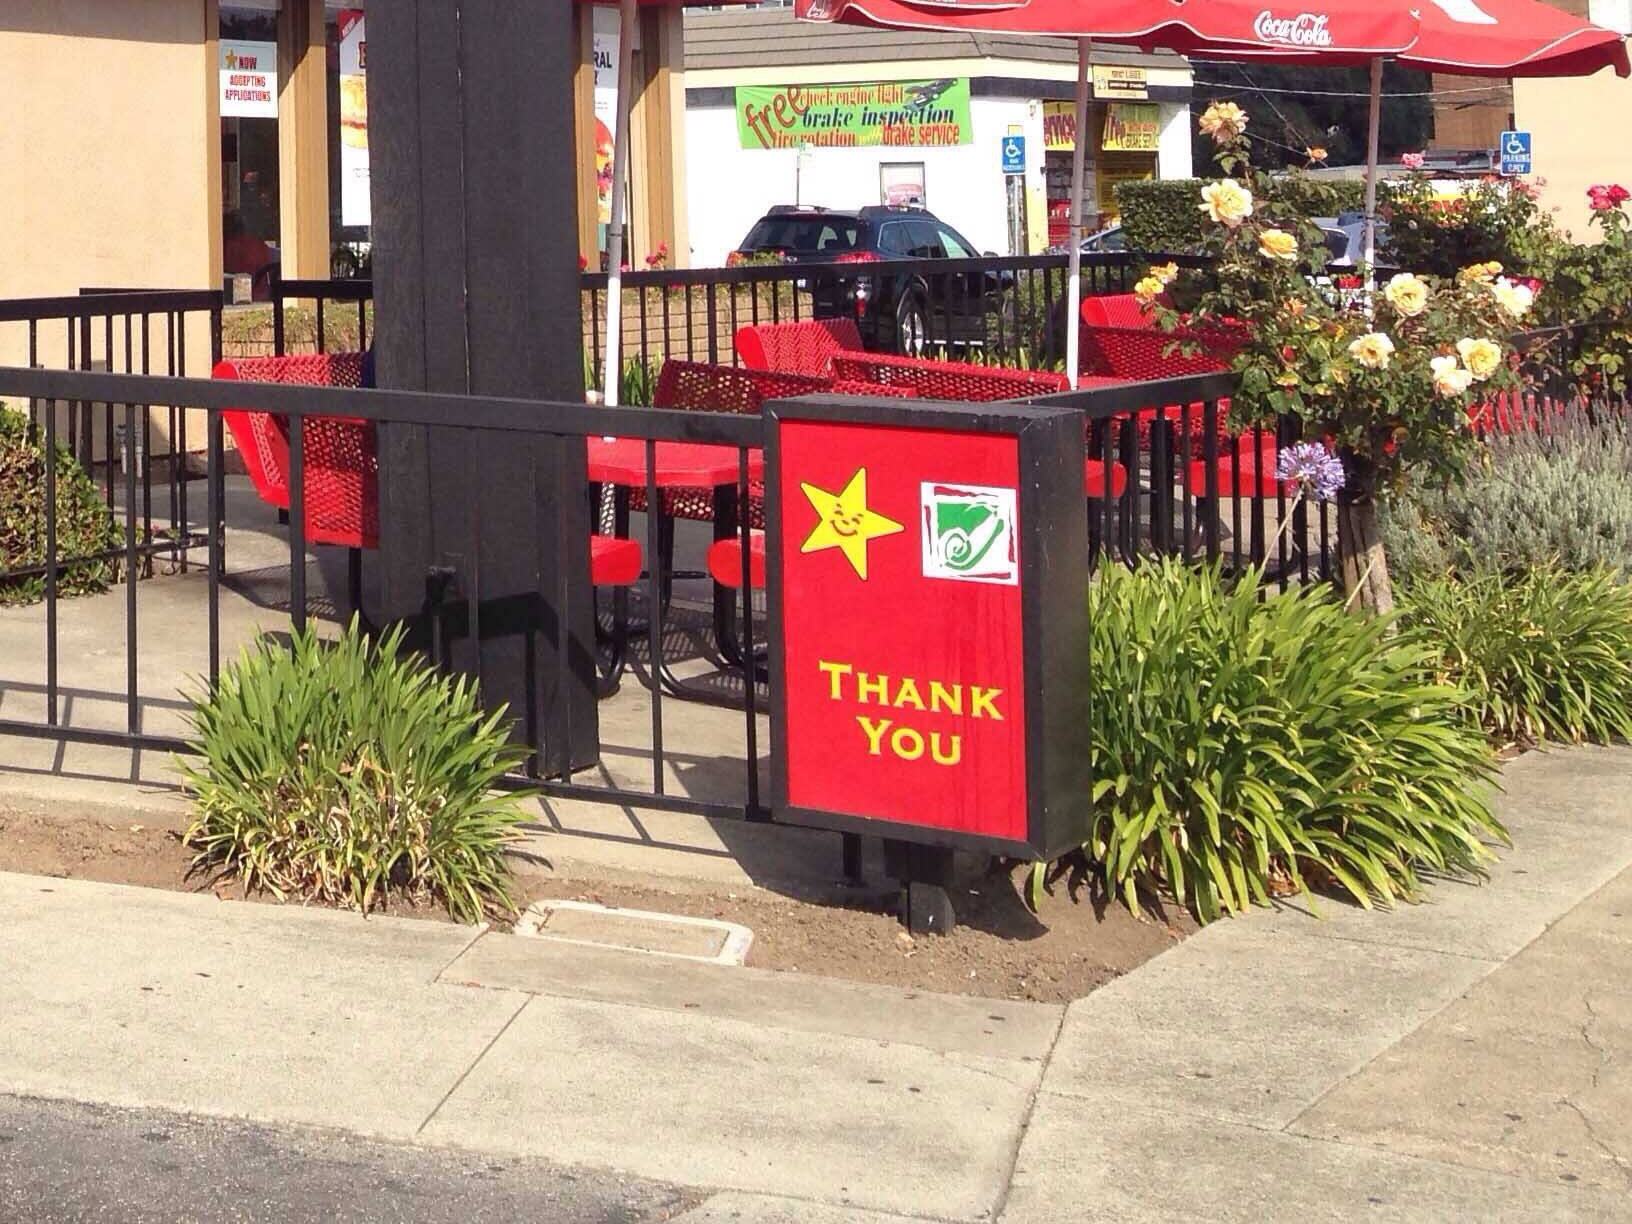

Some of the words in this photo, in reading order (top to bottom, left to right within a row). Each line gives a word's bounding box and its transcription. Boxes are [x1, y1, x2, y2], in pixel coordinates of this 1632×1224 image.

[1254, 9, 1333, 46] Coca-Cola
[238, 56, 257, 70] NOW
[744, 84, 808, 150] free
[802, 107, 853, 127] brake
[861, 104, 954, 127] inspection
[919, 124, 960, 145] service
[819, 660, 1004, 721] THANK
[857, 716, 962, 766] YOU
